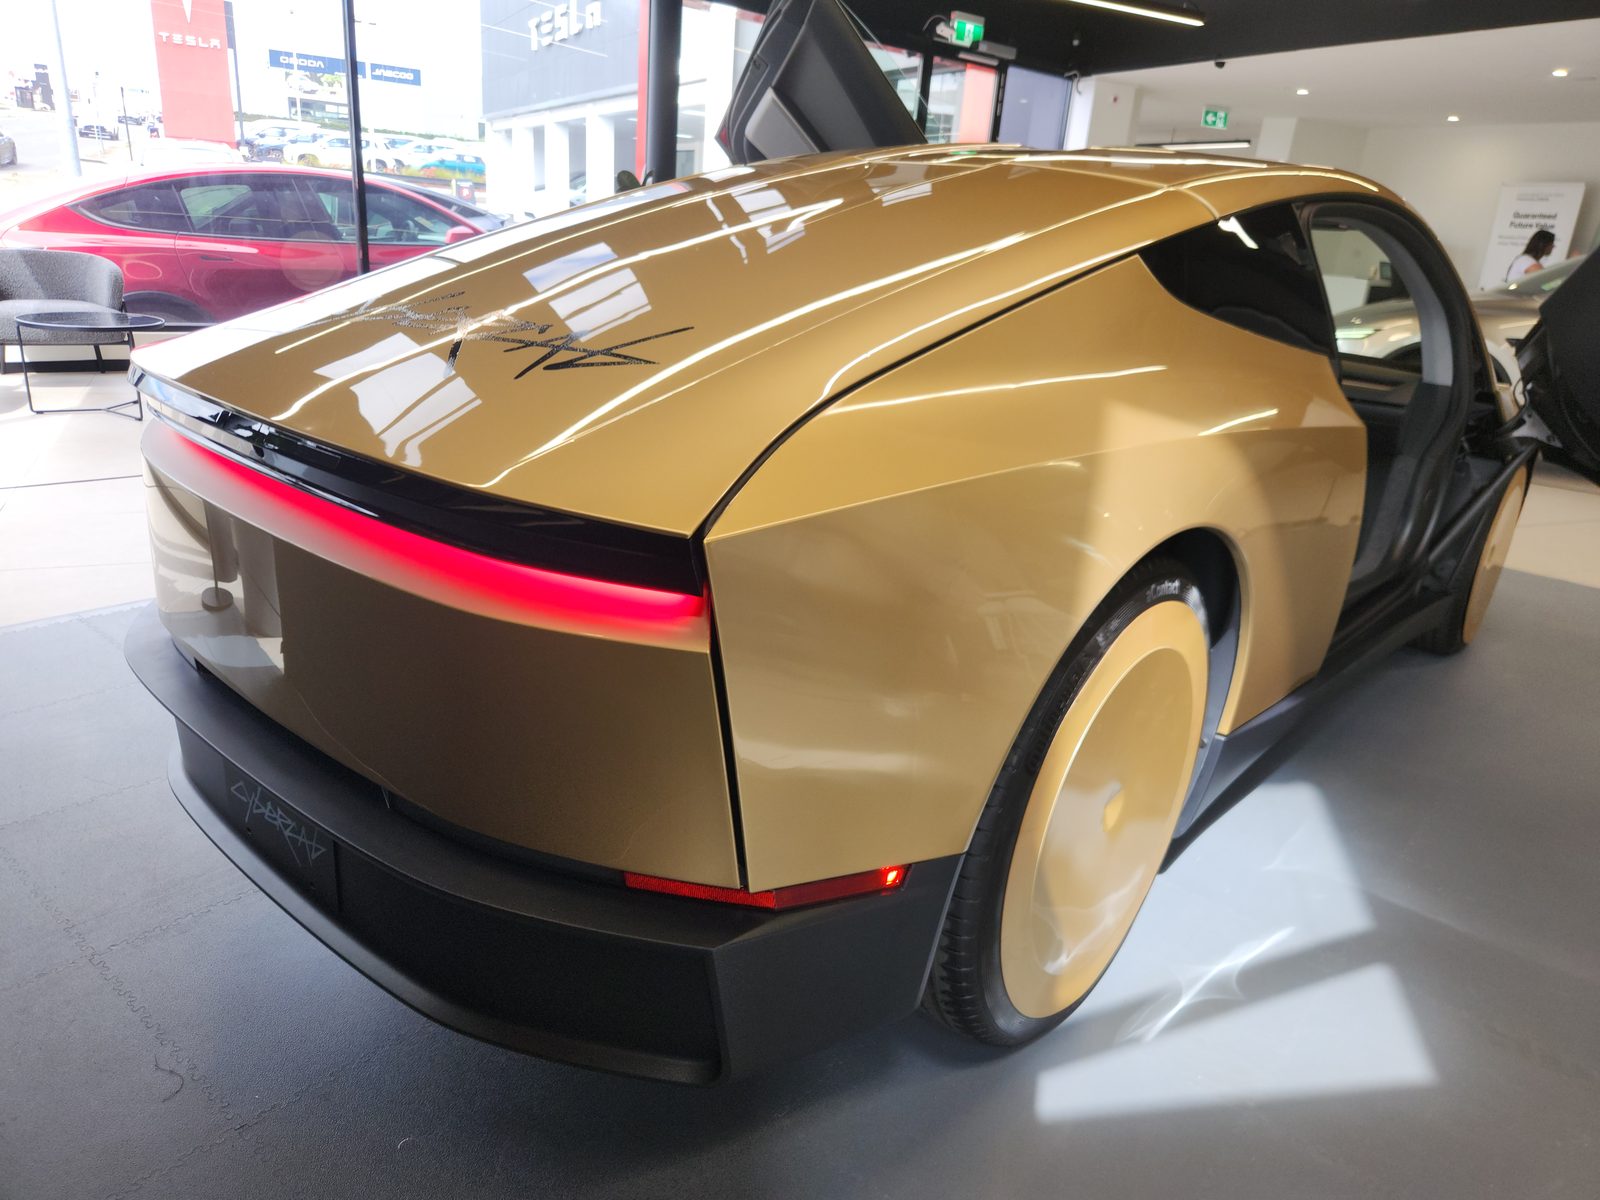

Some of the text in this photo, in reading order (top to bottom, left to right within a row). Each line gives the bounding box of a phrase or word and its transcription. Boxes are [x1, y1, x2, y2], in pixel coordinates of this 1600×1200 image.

[527, 0, 602, 52] TESLA
[158, 31, 221, 49] TESLA
[1513, 211, 1558, 220] Guaranteed
[1509, 221, 1556, 230] Future Value
